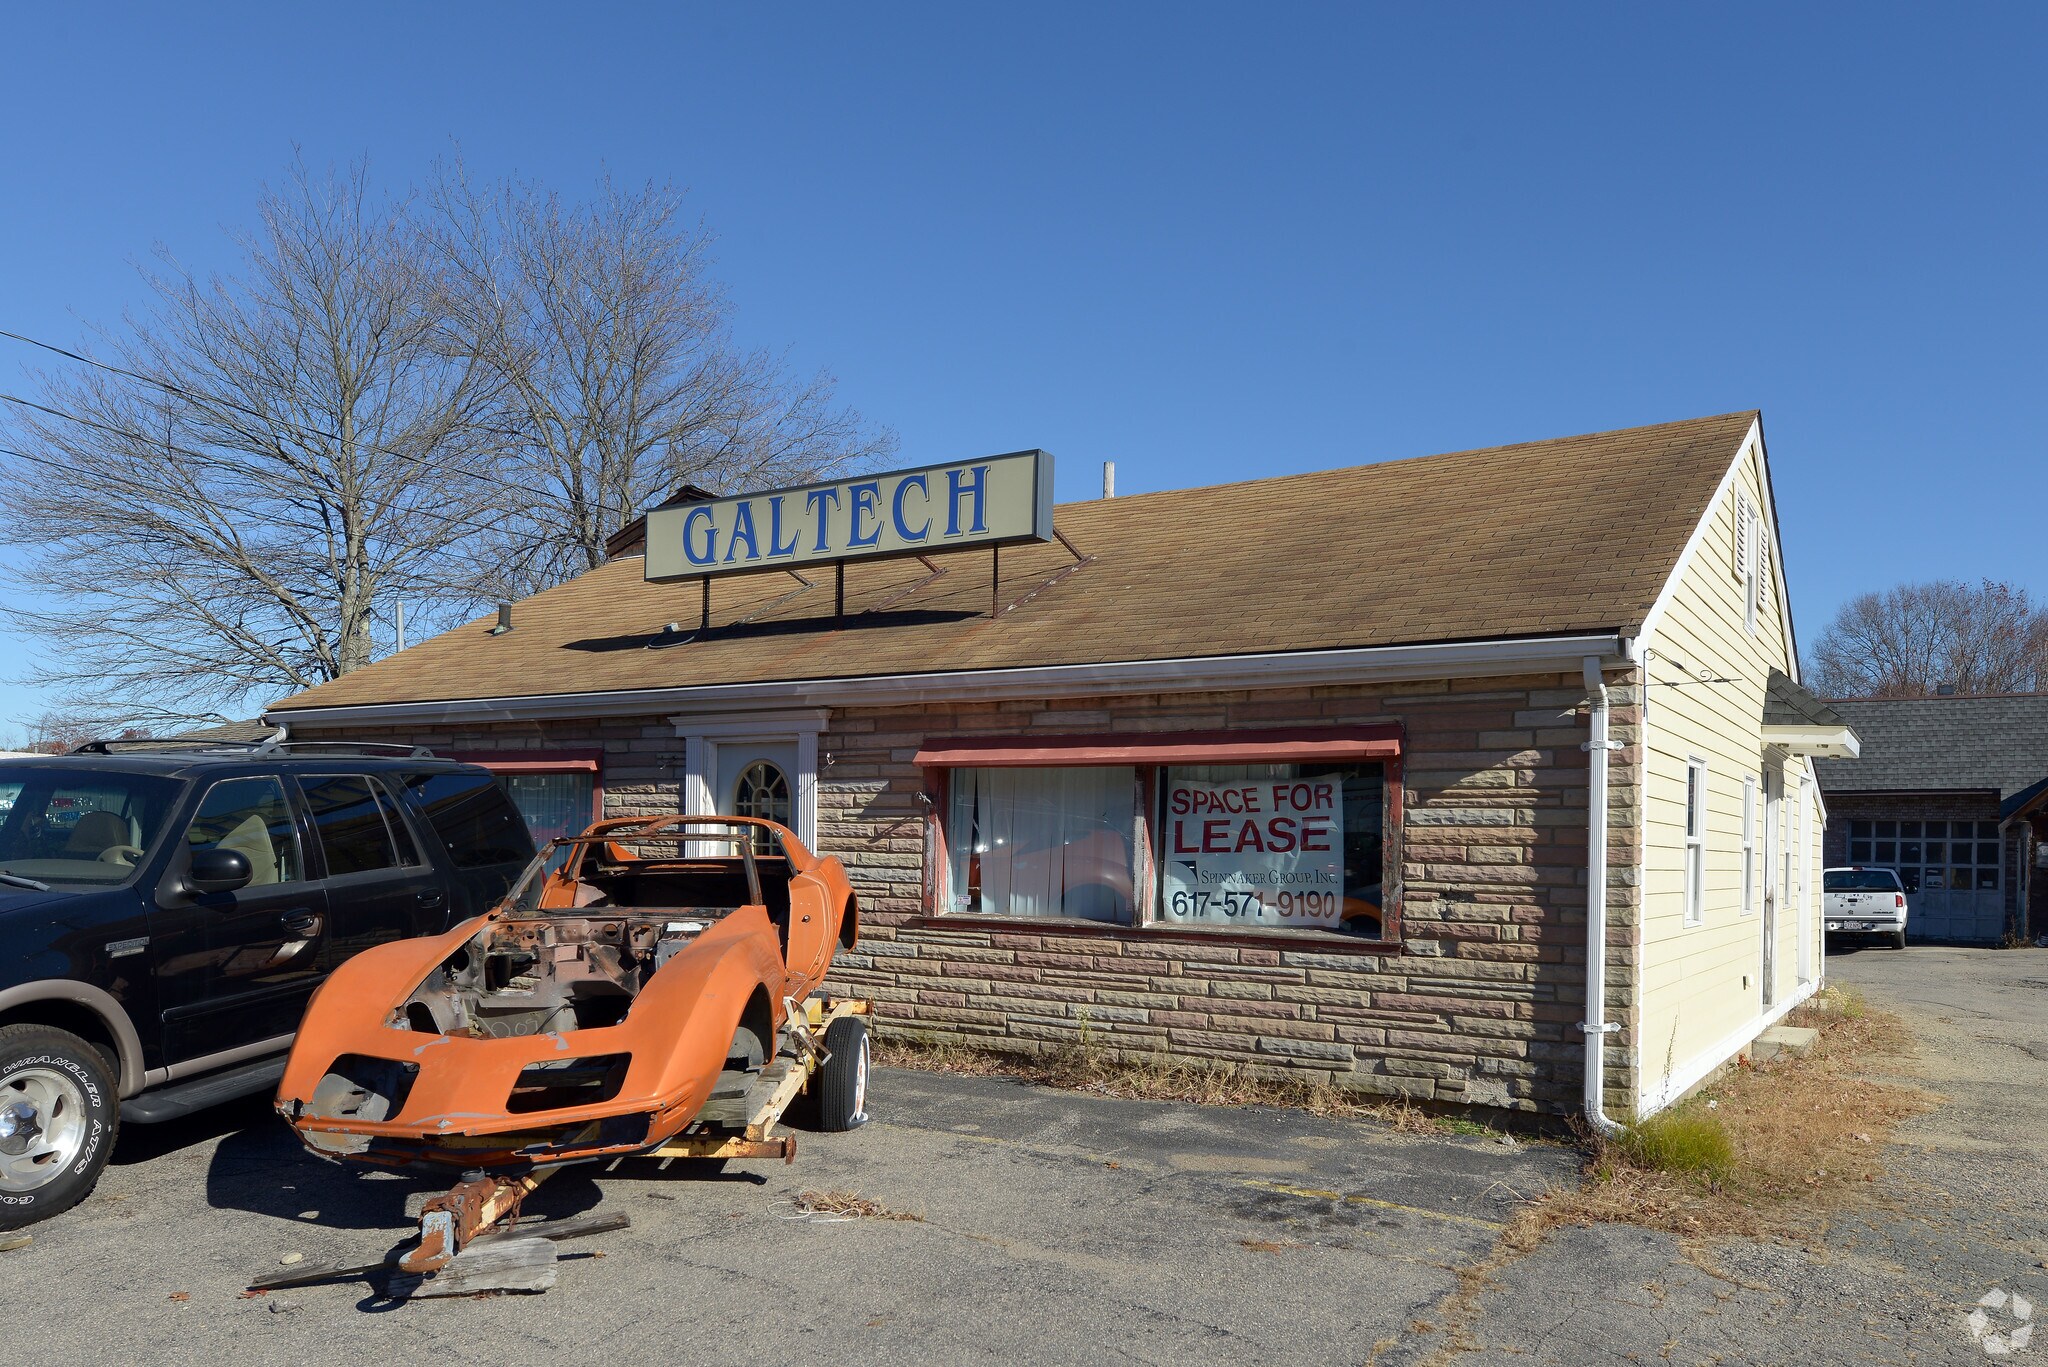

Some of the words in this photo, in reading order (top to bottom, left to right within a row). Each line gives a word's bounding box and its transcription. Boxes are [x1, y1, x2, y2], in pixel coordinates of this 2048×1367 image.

[682, 465, 991, 567] GALTECH
[1171, 787, 1261, 815] SPACE
[1272, 783, 1334, 812] FOR
[1173, 815, 1331, 854] LEASE
[1171, 890, 1336, 919] 617-571-9190
[3, 1055, 102, 1108] WRANGLER
